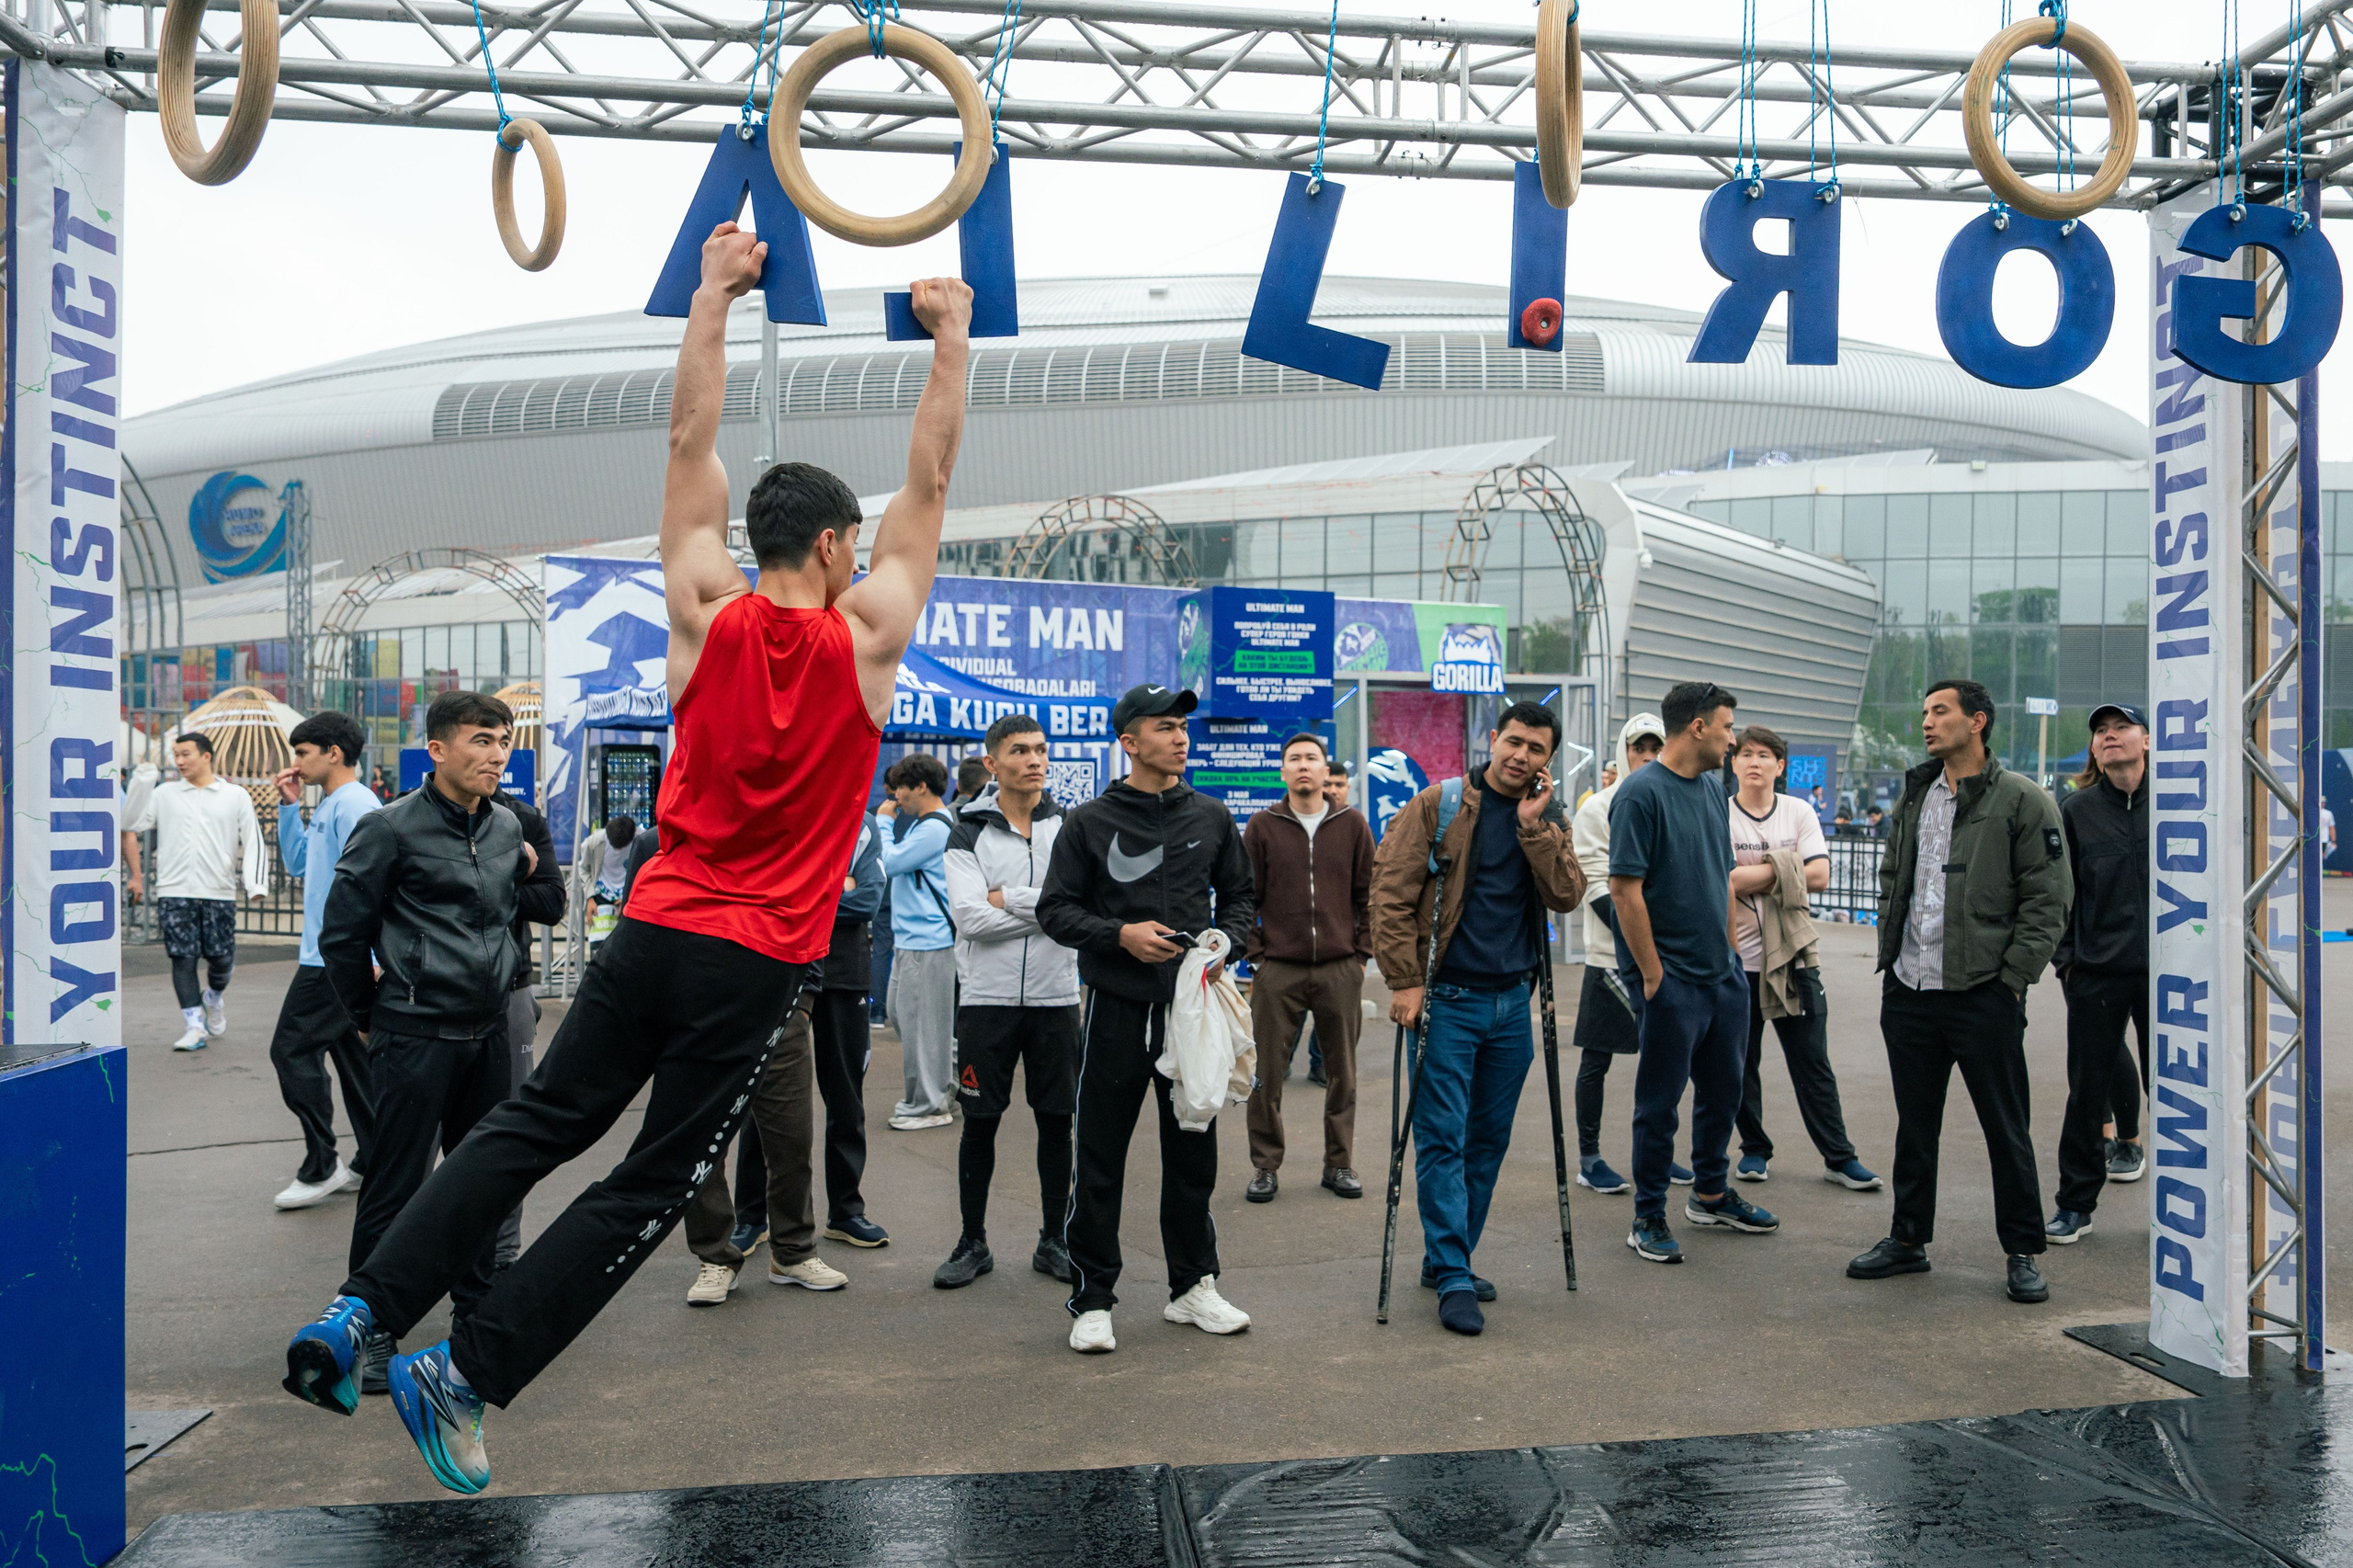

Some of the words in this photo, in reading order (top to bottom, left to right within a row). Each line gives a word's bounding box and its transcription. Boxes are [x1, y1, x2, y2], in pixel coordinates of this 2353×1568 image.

[50, 186, 118, 692] INSTINCT
[1029, 606, 1123, 651] MAN
[1245, 603, 1284, 613] ULTIMATE
[1286, 604, 1305, 614] MAN
[1433, 664, 1504, 692] GORILLA
[886, 691, 938, 726] GA
[1050, 704, 1109, 736] BER
[1210, 724, 1247, 733] ULTIMATE
[1249, 724, 1267, 733] MAN
[2155, 697, 2209, 934] YOUR
[50, 737, 117, 1025] YOUR
[2155, 973, 2209, 1302] POWER
